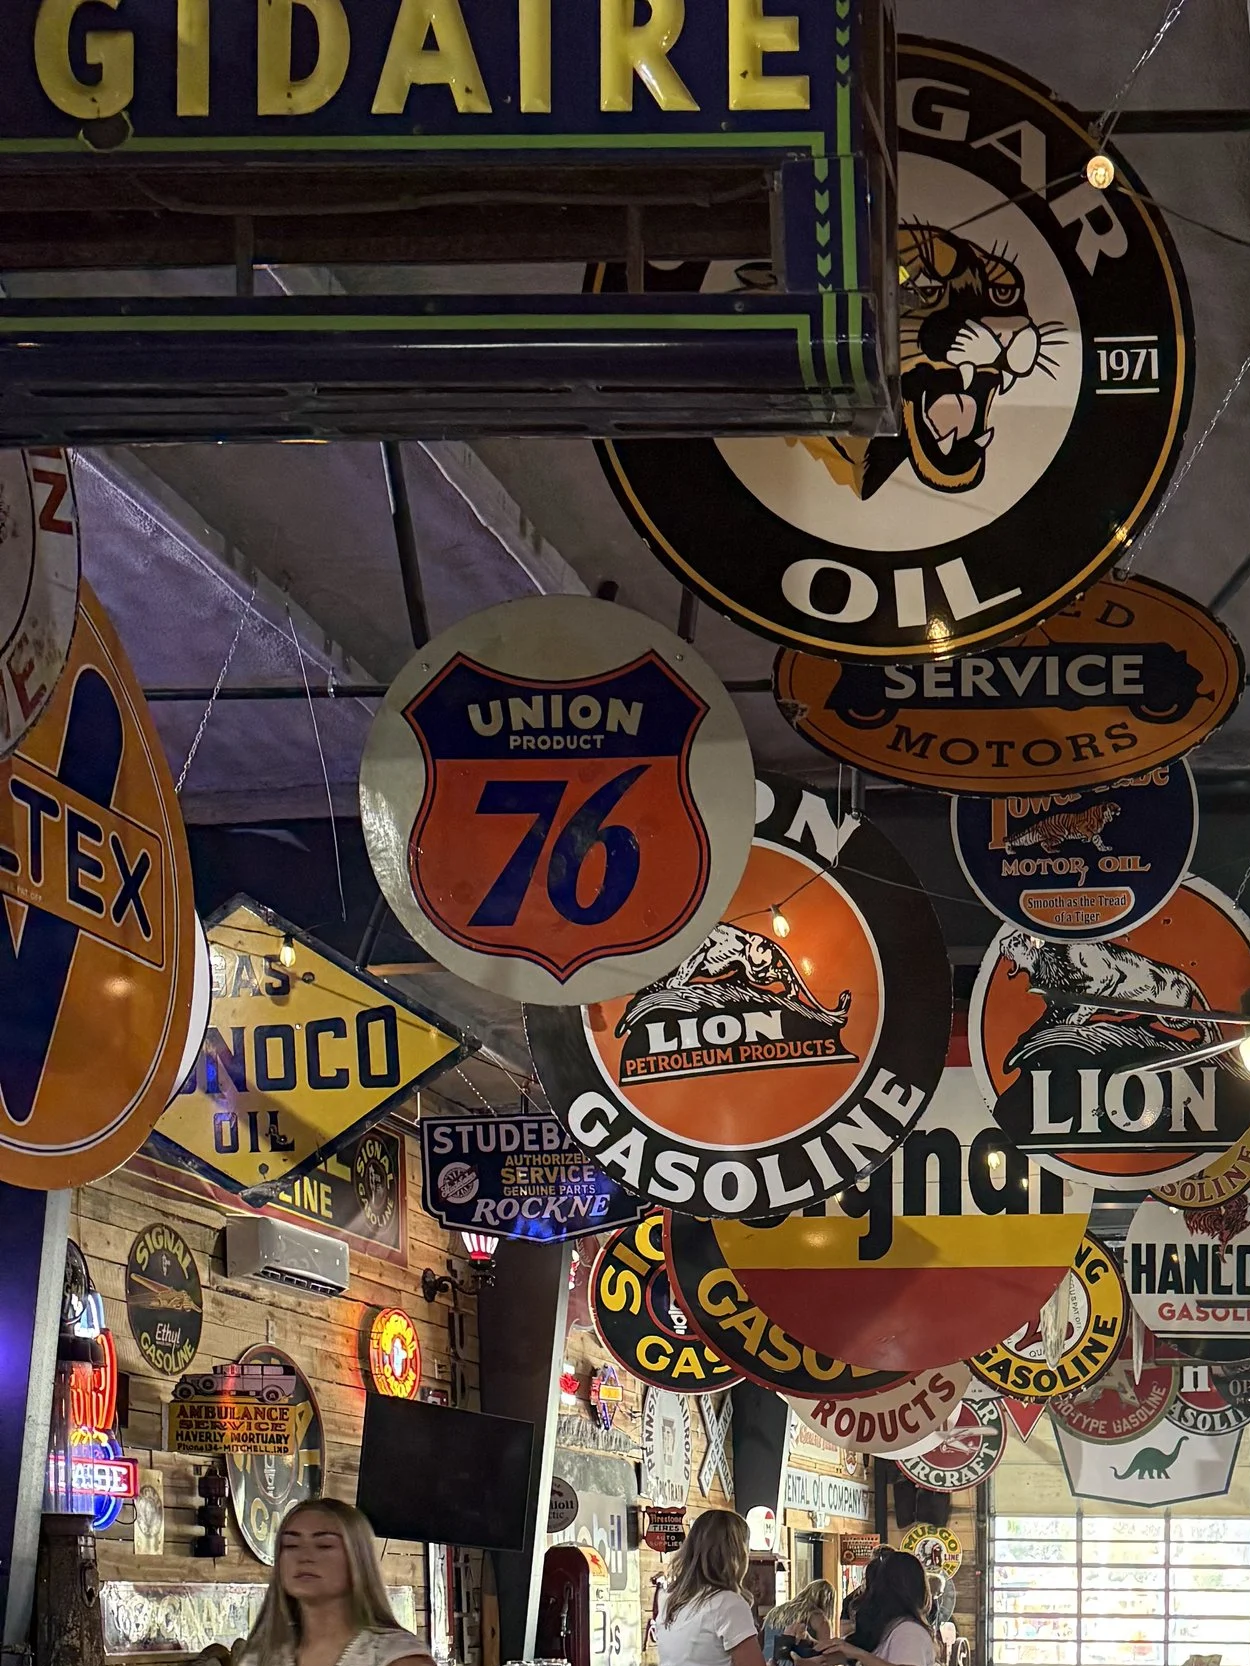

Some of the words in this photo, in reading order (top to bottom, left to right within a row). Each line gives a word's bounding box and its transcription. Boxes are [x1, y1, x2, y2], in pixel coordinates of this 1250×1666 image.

[1098, 346, 1159, 382] 1971
[781, 557, 1022, 628] OIL
[883, 653, 1146, 700] SERVICE
[467, 693, 644, 737] UNION
[508, 734, 605, 751] PRODUCT
[885, 722, 1140, 770] MOTORS
[466, 763, 654, 928] 76
[1001, 857, 1089, 886] MOTOR
[1098, 855, 1152, 872] OIL
[1027, 896, 1065, 909] Smooth
[1066, 898, 1076, 908] as
[1077, 896, 1095, 908] the
[1098, 894, 1127, 906] Tread
[1054, 911, 1067, 923] of
[1074, 910, 1101, 924] Tiger
[646, 1009, 786, 1055] LION
[624, 1048, 736, 1076] PETROLEUM
[738, 1038, 837, 1064] PRODUCTS
[1029, 1065, 1220, 1136] LION
[212, 1110, 295, 1154] OIL
[567, 1067, 927, 1214] GASOLINE
[356, 1139, 394, 1190] SIGNAL
[500, 1165, 597, 1185] SERVICE
[358, 1182, 395, 1229] GASOLINE
[503, 1184, 557, 1197] GENUINE
[559, 1184, 596, 1195] PARTS
[471, 1193, 611, 1226] ROCKNE
[135, 1226, 193, 1280] SIGNAL
[138, 1331, 197, 1374] GASOLINE
[154, 1322, 182, 1353] Ethyl
[175, 1404, 291, 1422] AMBULANCE
[177, 1420, 287, 1432] SERVICE
[1111, 1383, 1168, 1434] GASOLINE
[175, 1431, 226, 1444] HAVERLY
[230, 1432, 291, 1445] MORTUARY
[650, 1513, 682, 1524] Firestone
[652, 1524, 680, 1532] TIRES
[903, 1525, 959, 1553] MUSGO
